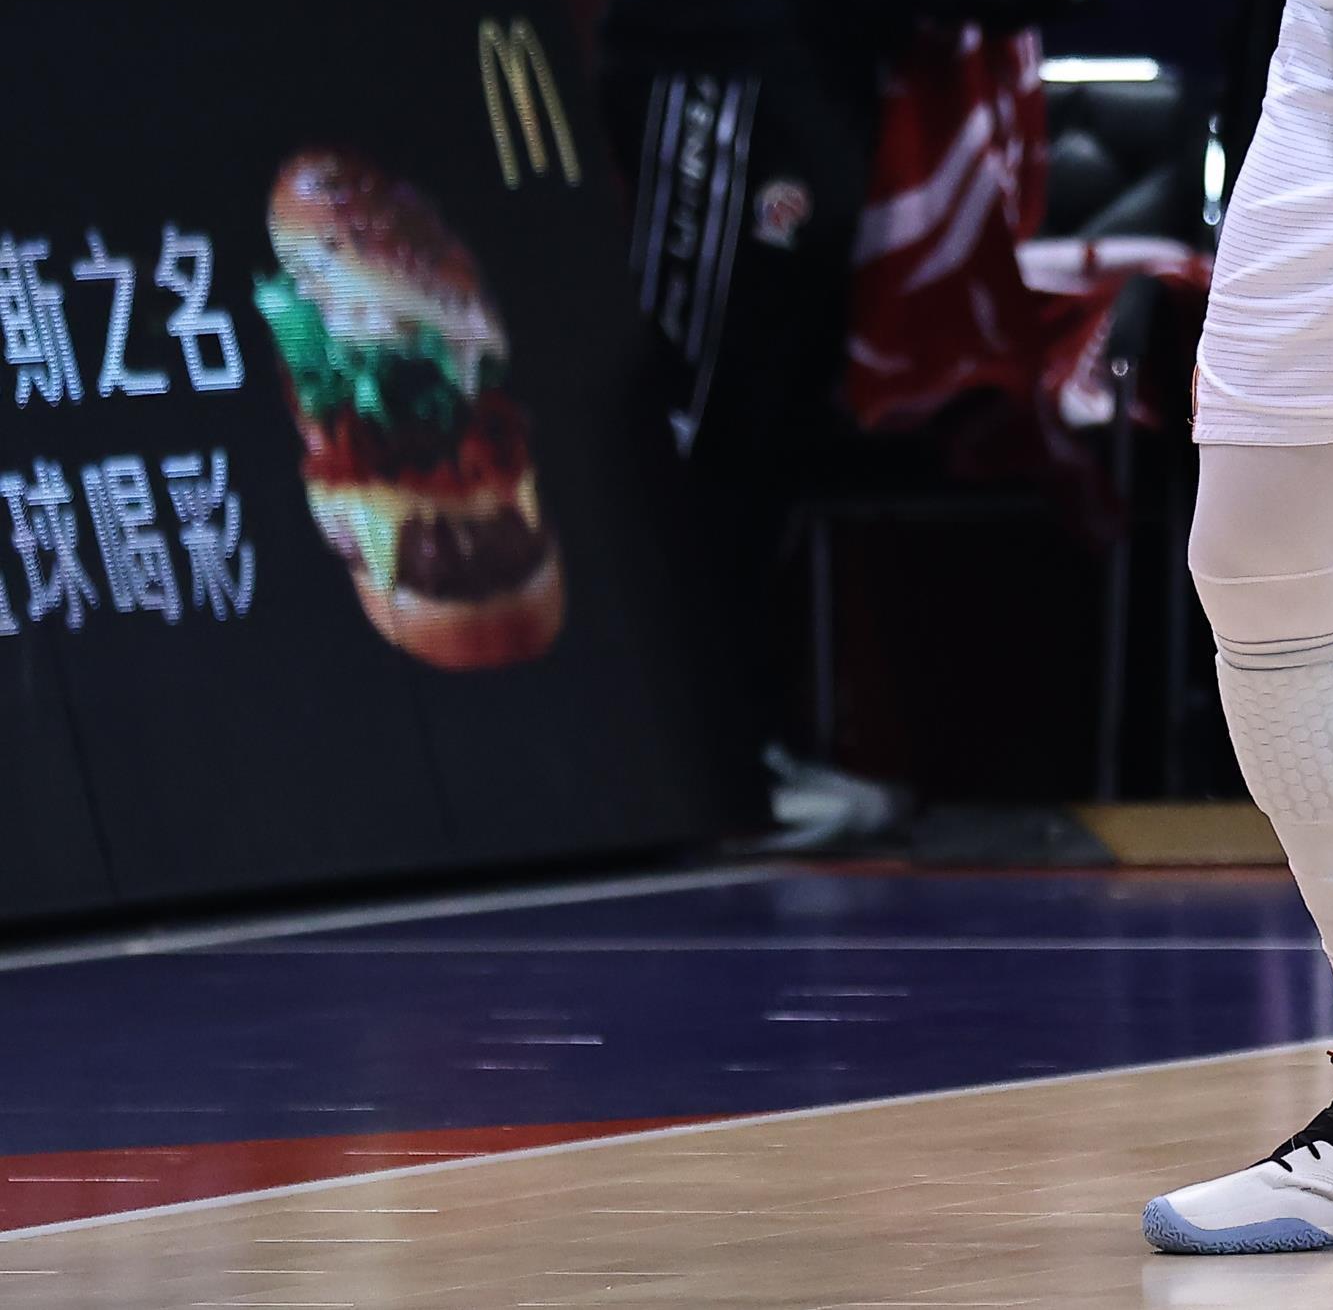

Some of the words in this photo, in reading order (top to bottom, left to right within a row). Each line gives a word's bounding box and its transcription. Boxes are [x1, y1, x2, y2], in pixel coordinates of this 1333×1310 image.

[0, 224, 246, 408] 斯之名
[0, 447, 257, 636] 球喝彩
